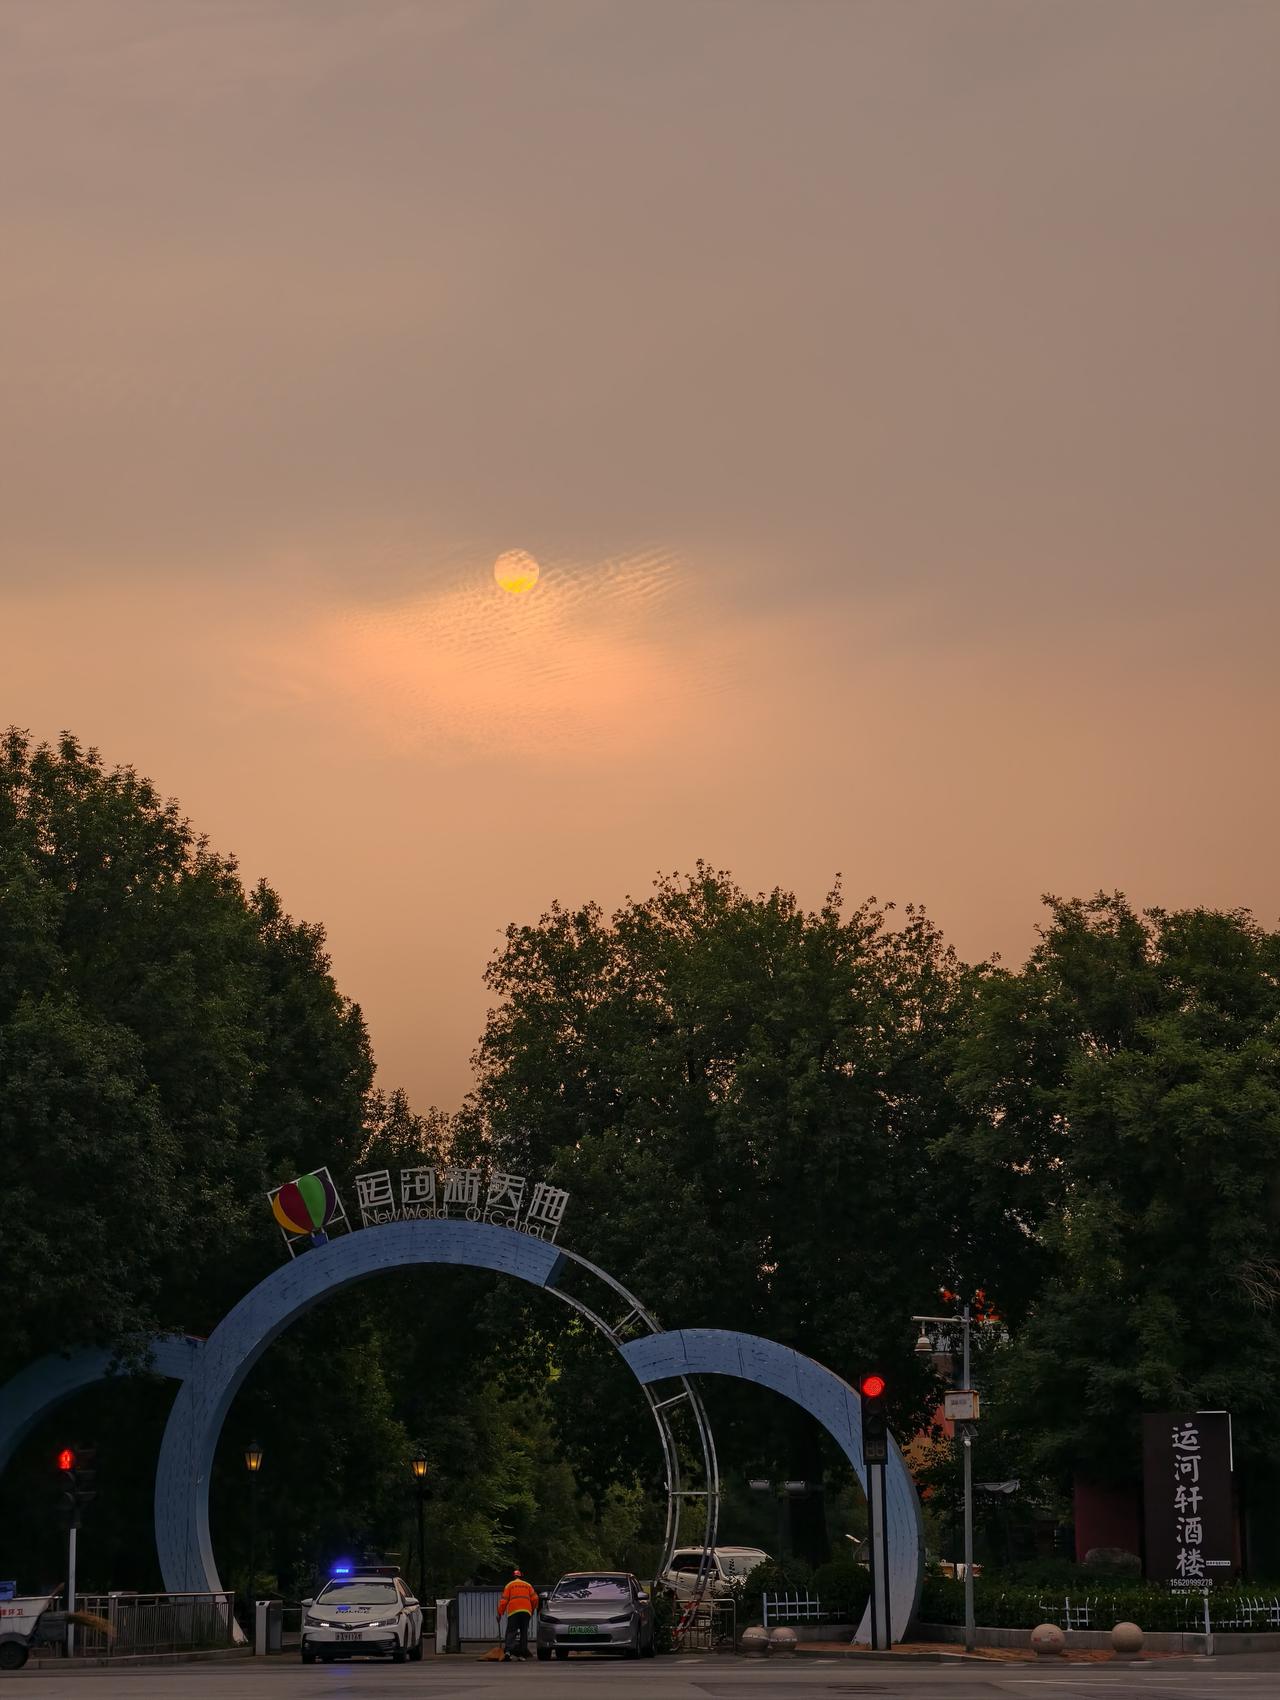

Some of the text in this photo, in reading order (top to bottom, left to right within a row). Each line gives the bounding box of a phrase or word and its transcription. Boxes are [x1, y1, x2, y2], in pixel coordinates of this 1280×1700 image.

[356, 1167, 570, 1225] 运河新天地
[1171, 1422, 1206, 1577] 运河轩酒楼
